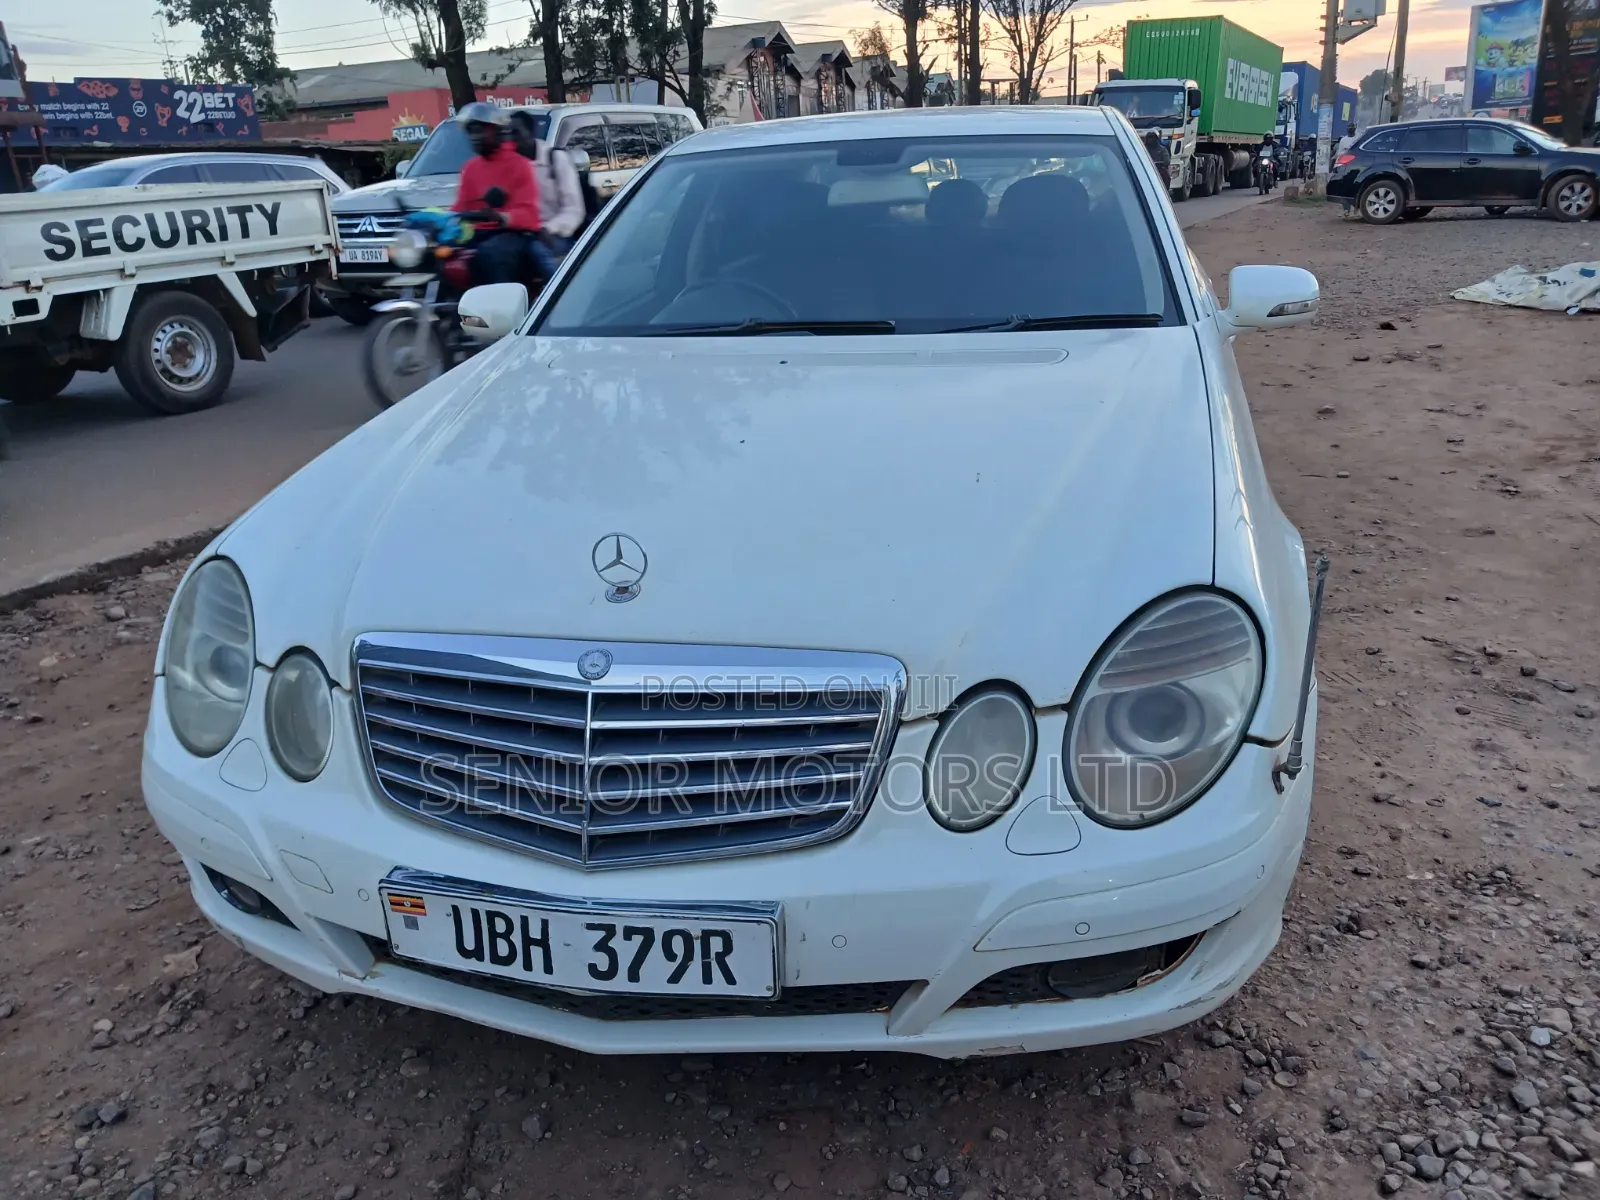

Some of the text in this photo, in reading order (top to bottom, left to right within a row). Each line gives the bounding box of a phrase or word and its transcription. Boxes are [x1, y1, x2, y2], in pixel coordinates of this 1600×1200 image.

[17, 102, 110, 112] Evey match begins with 22
[524, 94, 543, 107] the
[42, 112, 56, 120] win
[56, 112, 80, 121] begins
[80, 111, 94, 119] with
[392, 126, 429, 141] REGAL
[40, 202, 281, 261] SECURITY
[348, 250, 359, 261] UA
[451, 904, 738, 986] UBH 379R
